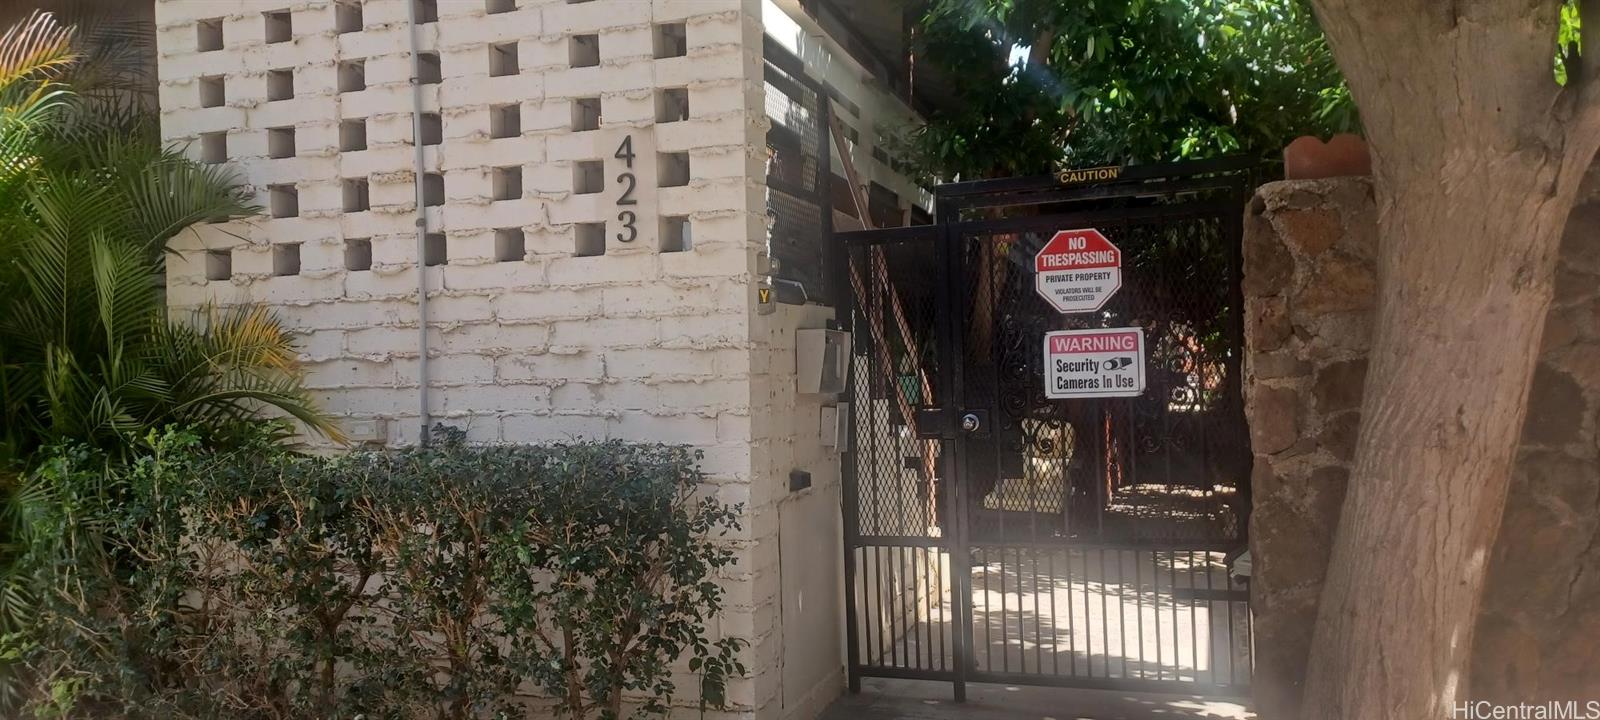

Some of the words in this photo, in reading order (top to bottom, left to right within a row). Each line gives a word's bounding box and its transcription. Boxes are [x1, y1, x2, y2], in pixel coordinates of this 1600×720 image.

[1060, 168, 1118, 183] CAUTION
[615, 135, 637, 243] 423
[1068, 236, 1087, 250] NO
[1041, 250, 1115, 267] TRESPASSING
[1045, 273, 1074, 283] PRIVATE
[1075, 271, 1111, 282] PROPERTY
[1054, 287, 1082, 295] VIOLATORS
[1082, 286, 1094, 294] WILL
[1062, 294, 1095, 302] PROSECUTED
[1054, 335, 1134, 352] WARNING
[1056, 358, 1100, 374] Security
[1057, 376, 1100, 390] Cameras
[1102, 374, 1112, 389] In
[1115, 374, 1134, 388] Use
